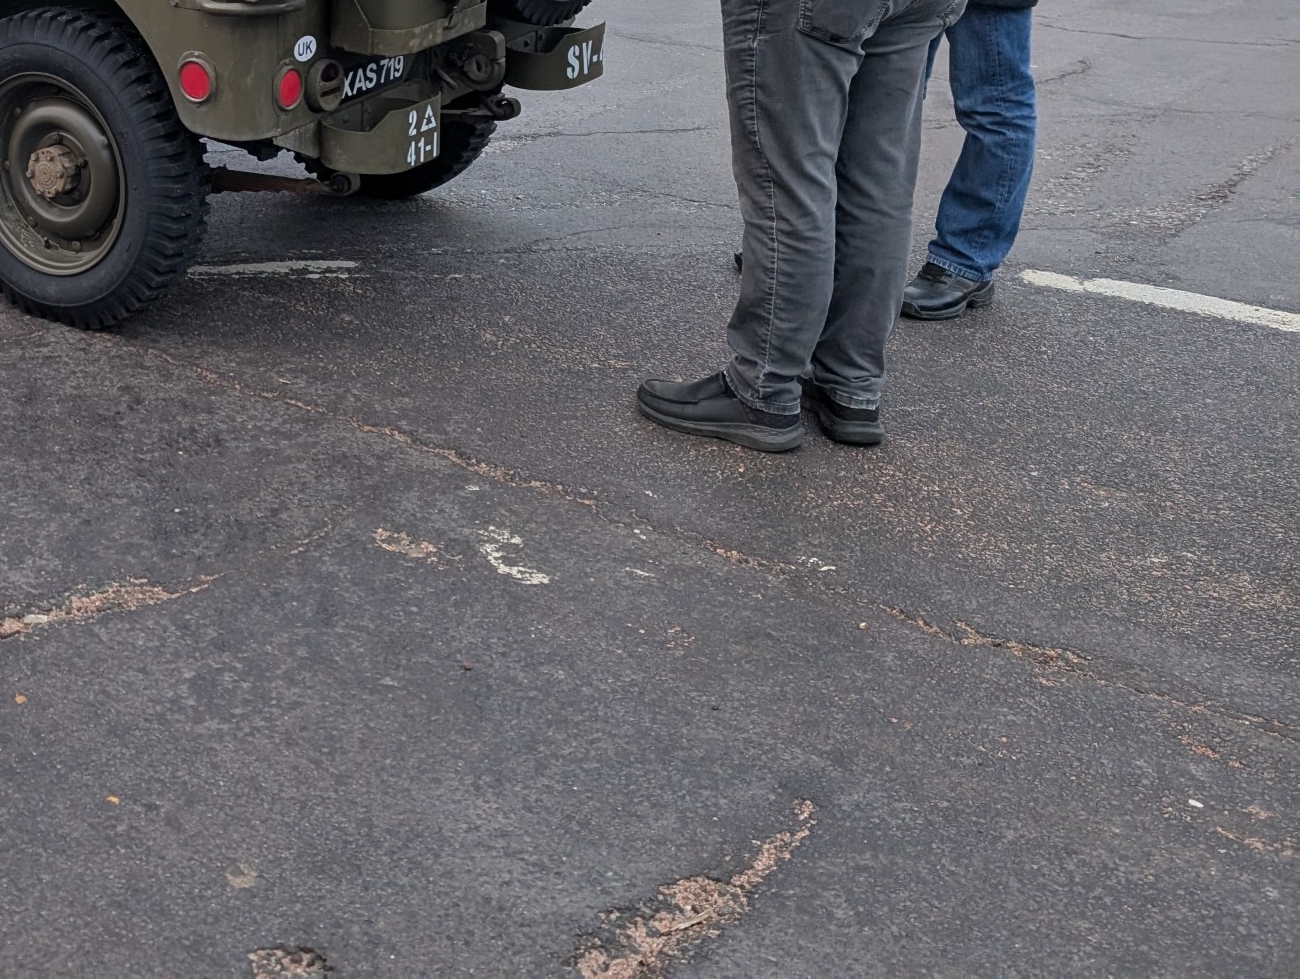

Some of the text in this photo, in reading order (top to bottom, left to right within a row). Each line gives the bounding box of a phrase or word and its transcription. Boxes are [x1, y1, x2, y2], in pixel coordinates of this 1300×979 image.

[297, 40, 313, 57] UK
[341, 55, 404, 99] XAS 719
